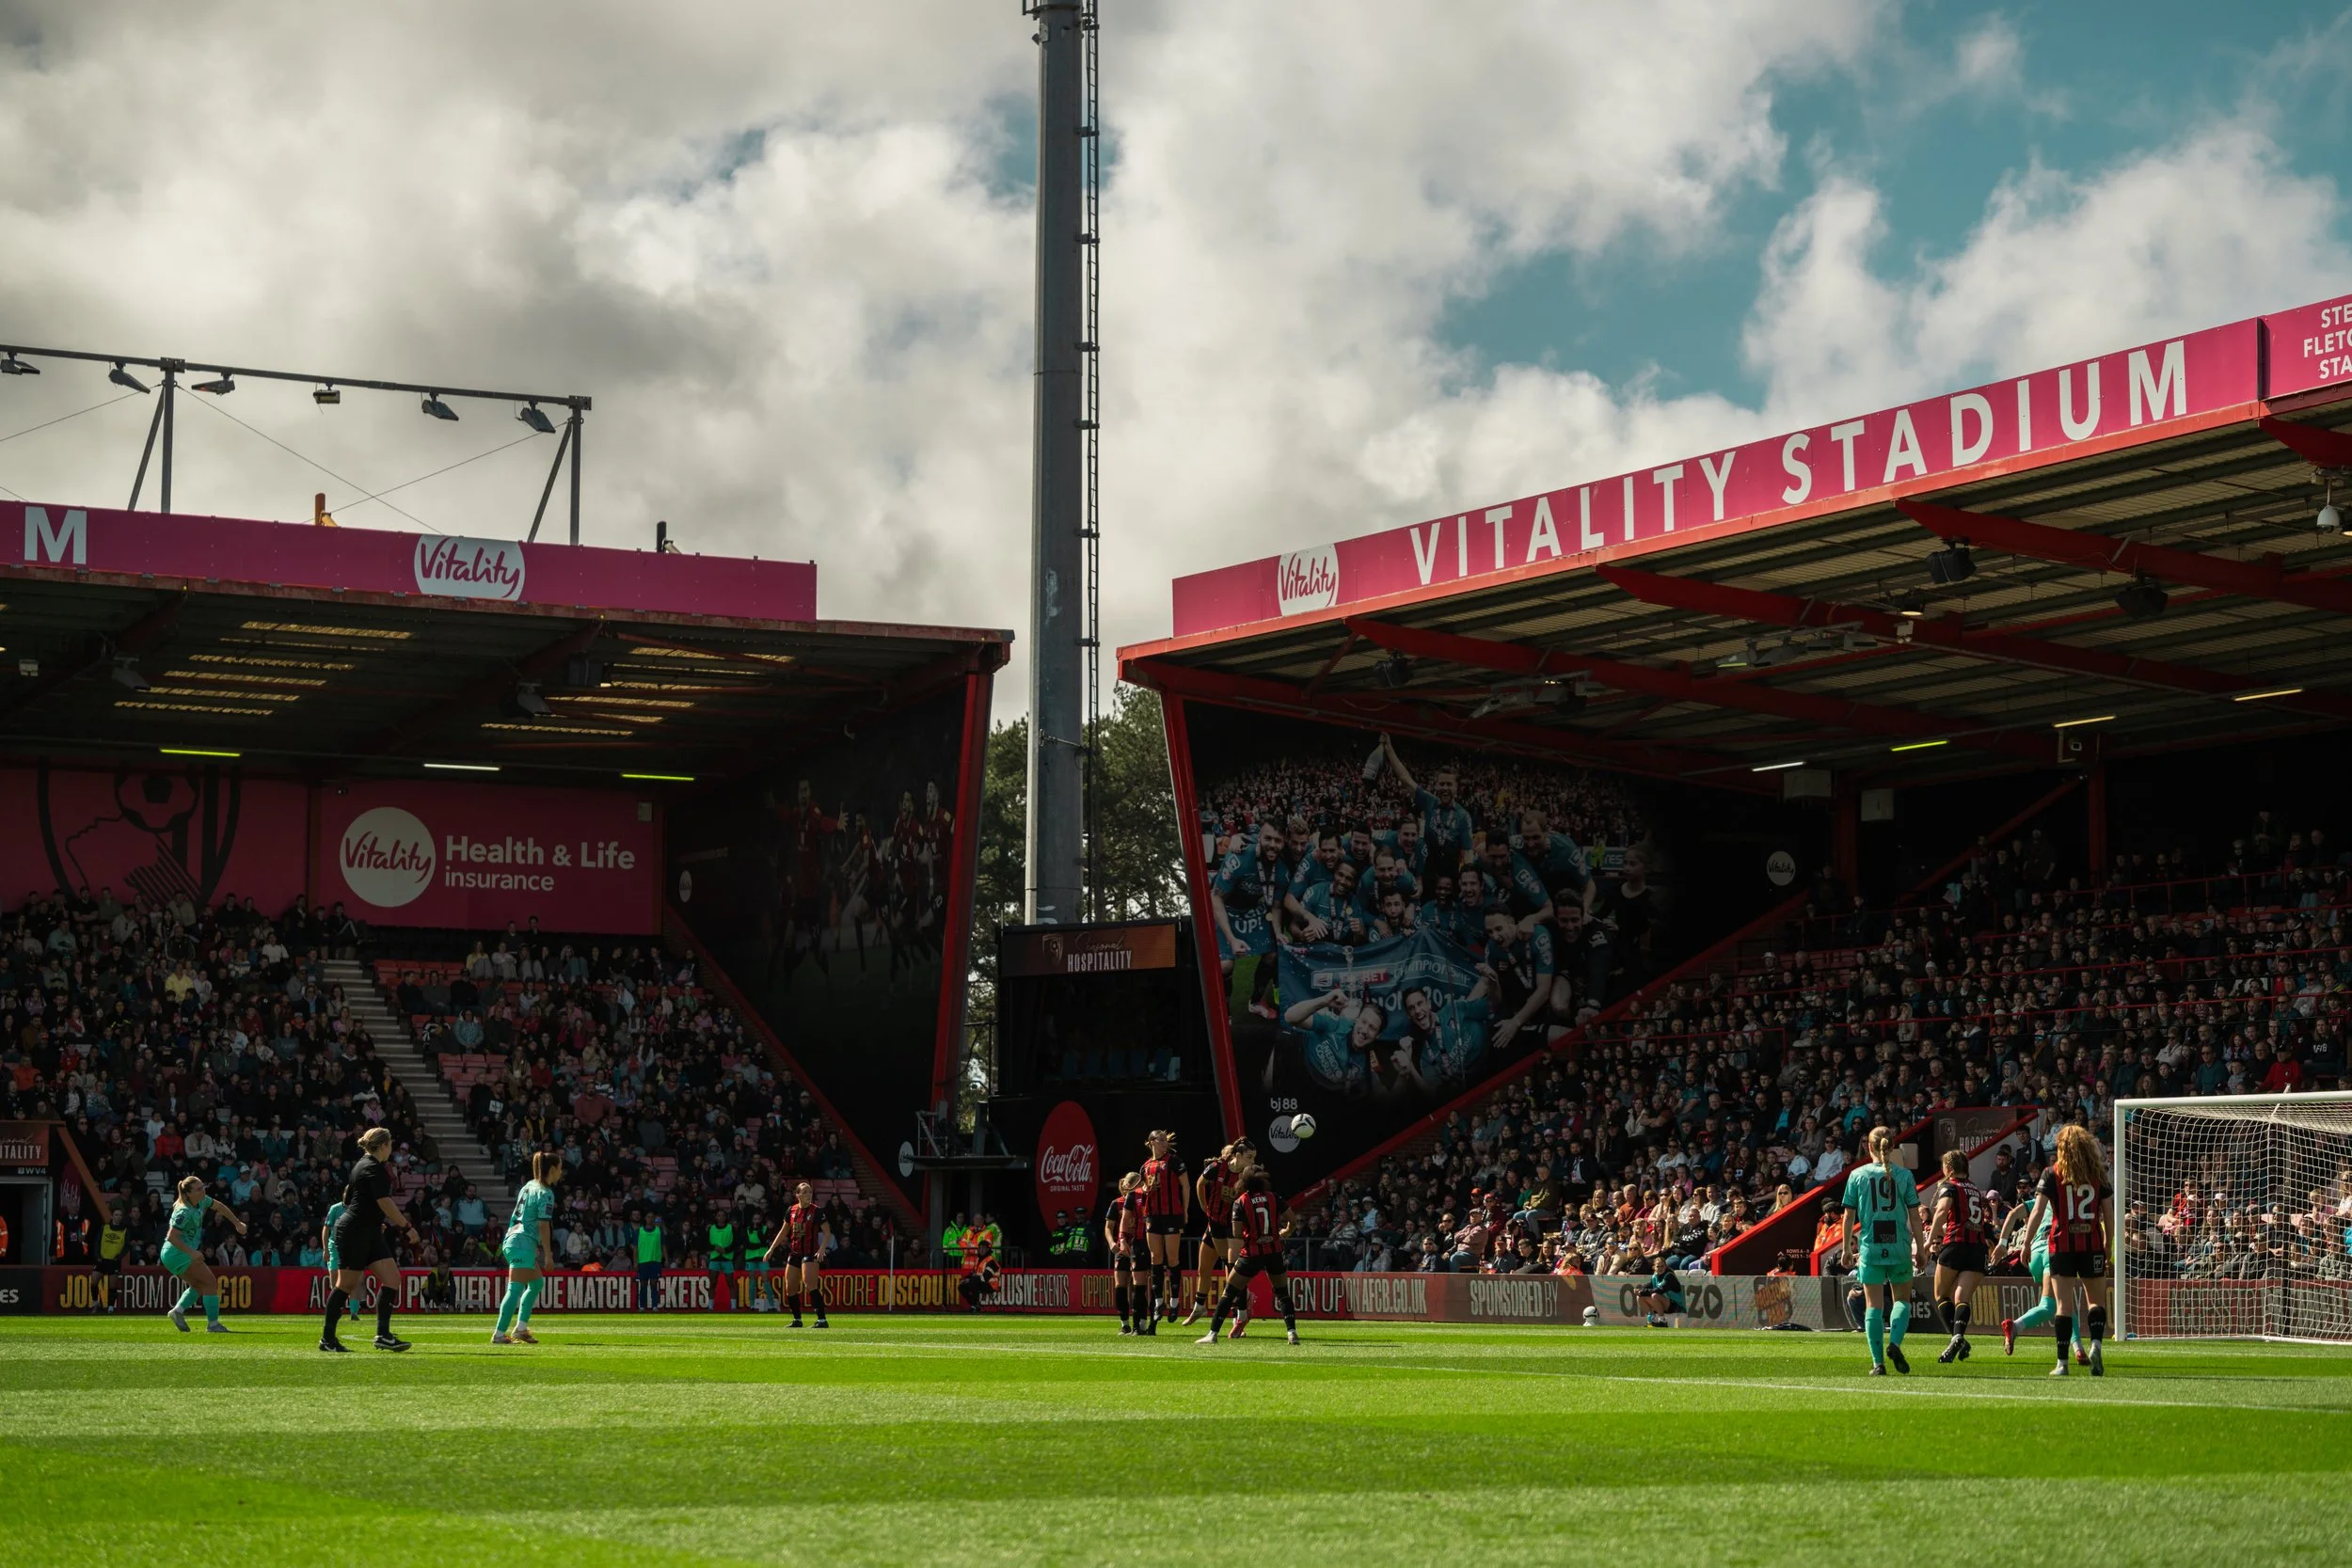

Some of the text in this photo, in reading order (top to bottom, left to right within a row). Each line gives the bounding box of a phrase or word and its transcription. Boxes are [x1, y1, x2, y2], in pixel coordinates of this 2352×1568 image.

[1409, 340, 2187, 586] VITALITY STADIUM
[24, 506, 87, 564] M
[421, 536, 520, 598] Vitality
[1280, 553, 1336, 608] Vitality
[345, 831, 433, 884] Vitality
[445, 834, 636, 870] Health & Life
[445, 865, 555, 893] insurance
[1075, 927, 1126, 952] Seasonal
[1235, 916, 1263, 934] UP!
[1067, 950, 1132, 973] HOSPITALITY
[1270, 1097, 1298, 1113] bj88
[1869, 1176, 1897, 1213] 19
[1968, 1196, 1982, 1225] 6
[2065, 1182, 2096, 1221] 12
[1255, 1207, 1269, 1235] 7
[567, 1275, 631, 1308] MATCH
[877, 1275, 961, 1307] DISCOUNT
[1039, 1275, 1069, 1307] EVENTS
[1322, 1277, 1343, 1313] UP
[1346, 1277, 1360, 1313] ON
[1362, 1277, 1427, 1314] AFCB.CO.UK
[1470, 1278, 1559, 1318] SPONSORED BY
